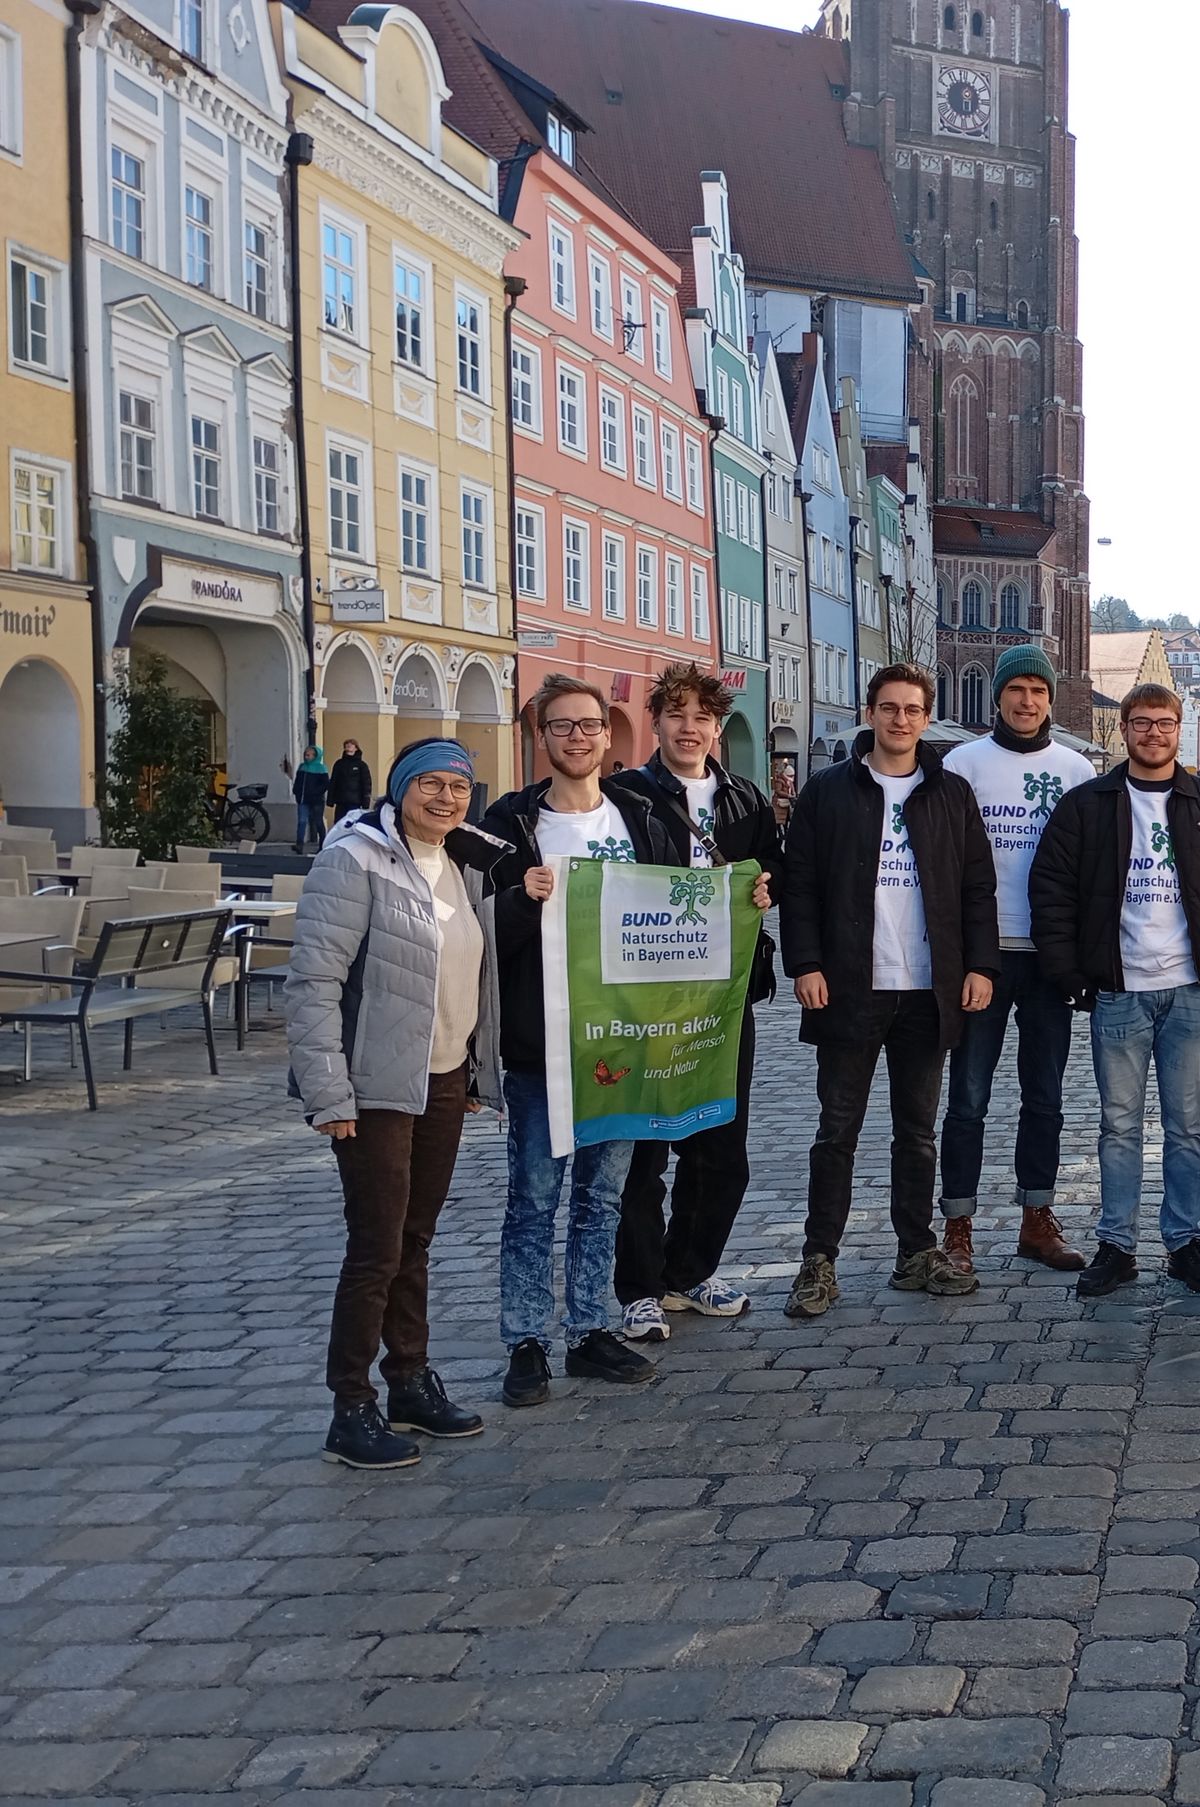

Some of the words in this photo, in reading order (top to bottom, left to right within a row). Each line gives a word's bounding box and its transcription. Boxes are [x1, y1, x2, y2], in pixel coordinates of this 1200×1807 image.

[194, 579, 243, 602] PANDORA
[0, 604, 56, 638] mair
[394, 679, 429, 703] endOptic
[982, 805, 1027, 818] BUND
[984, 822, 1044, 835] Naturschu
[995, 837, 1035, 852] Bayern
[1128, 857, 1154, 870] ND
[1128, 875, 1181, 889] turschut
[1126, 891, 1162, 905] Bayern
[621, 912, 672, 927] BUND
[622, 930, 708, 945] Naturschutz
[622, 949, 634, 962] in
[638, 949, 684, 964] Bayern
[687, 946, 708, 960] e.V.
[585, 1022, 604, 1040] In
[609, 1020, 676, 1041] Bayern
[682, 1014, 722, 1035] aktiv
[670, 1044, 686, 1061] für
[686, 1032, 726, 1052] Mensch
[643, 1064, 672, 1079] und
[674, 1059, 700, 1077] Natur
